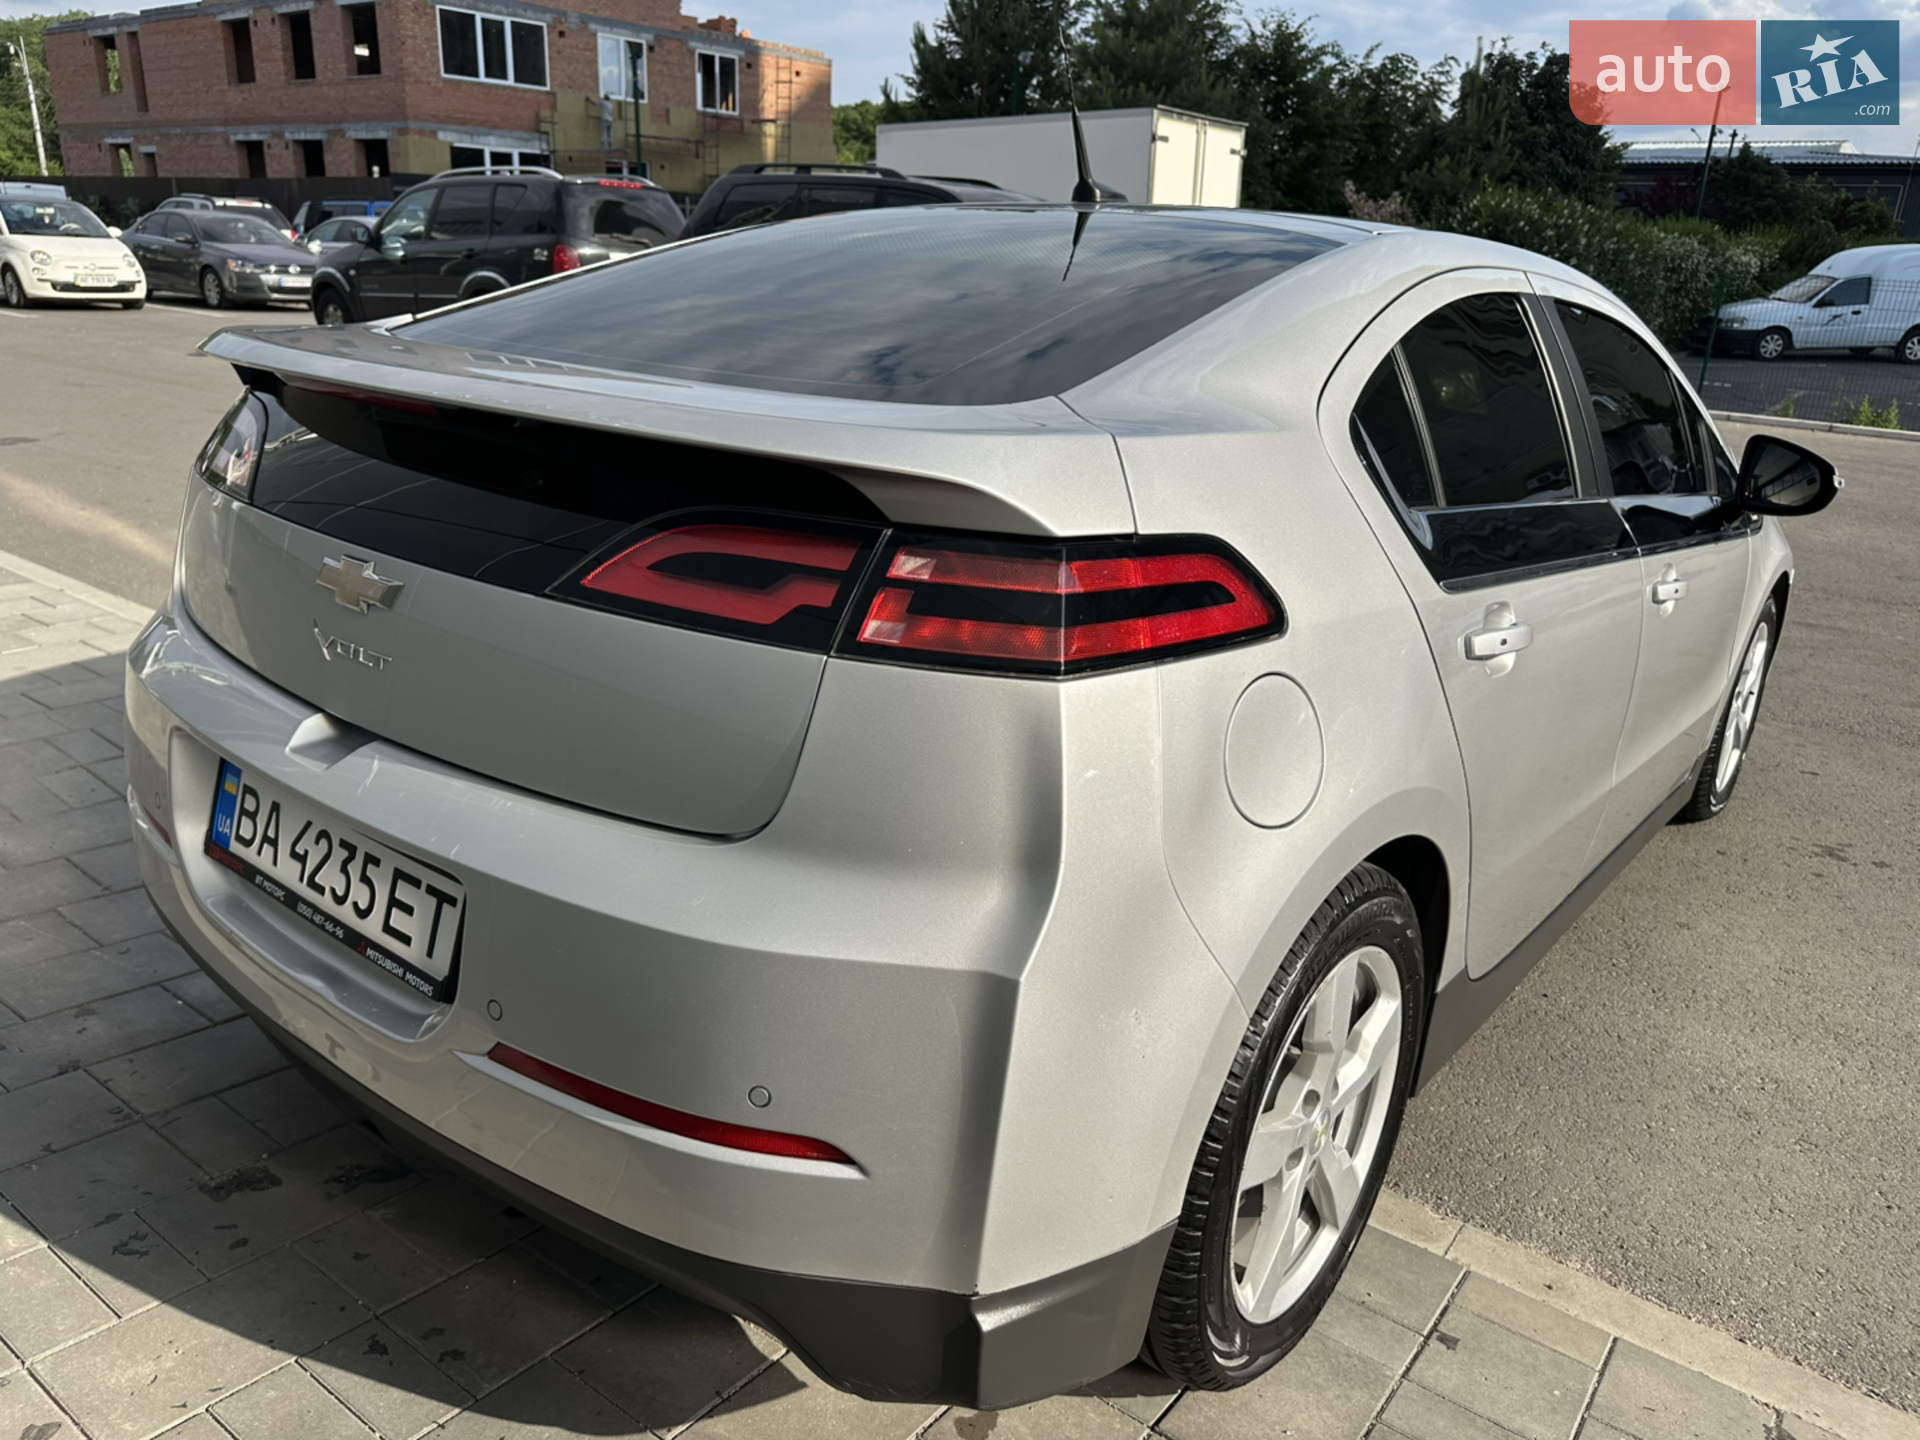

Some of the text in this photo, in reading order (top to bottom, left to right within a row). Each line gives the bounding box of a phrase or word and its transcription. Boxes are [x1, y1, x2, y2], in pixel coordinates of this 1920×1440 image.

[313, 619, 393, 670] VOLT
[217, 812, 231, 838] UA
[234, 783, 459, 960] BA 4235 ET
[365, 947, 435, 997] MITSUBISHI MOTORS
